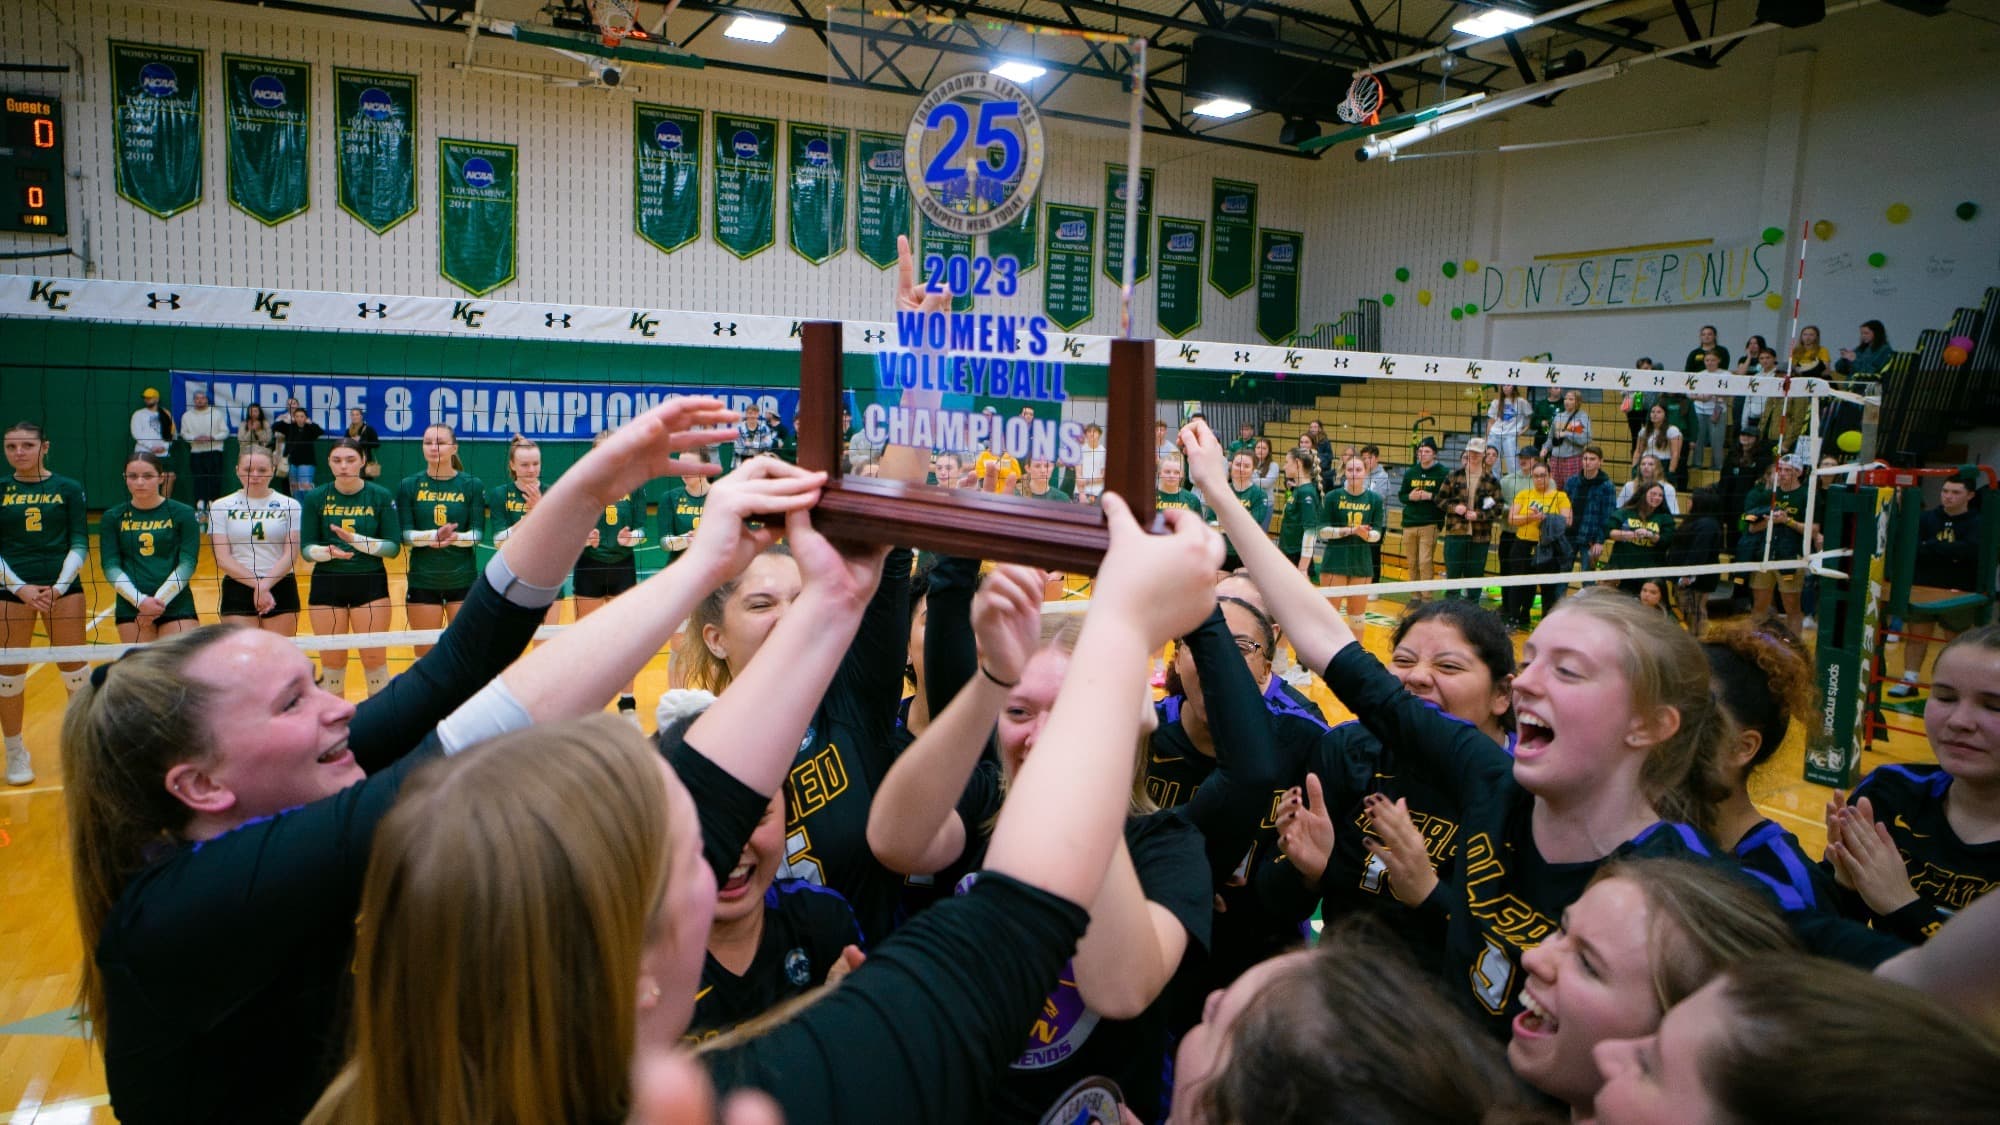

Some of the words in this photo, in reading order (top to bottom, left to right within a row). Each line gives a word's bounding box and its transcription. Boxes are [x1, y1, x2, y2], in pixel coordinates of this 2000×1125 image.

[120, 48, 160, 60] WOMEN'S
[161, 53, 194, 64] SOCCER
[239, 63, 263, 72] MEN'S
[264, 66, 296, 76] SOCCER
[143, 77, 178, 92] NCAA
[341, 75, 373, 85] WOMEN'S
[254, 89, 287, 105] NCAA
[915, 75, 987, 127] TOMORROW'S
[994, 78, 1037, 127] LEADERS
[6, 97, 51, 115] Guests
[237, 107, 300, 120] TOURNAMENT
[364, 101, 394, 115] NCAA
[34, 118, 54, 148] 0
[236, 122, 263, 132] 2007
[657, 132, 684, 146] NCAA
[925, 101, 1021, 183] 25
[449, 145, 470, 154] MEN'S
[735, 141, 760, 155] NCAA
[126, 152, 154, 162] 2010
[465, 170, 495, 184] NCAA
[28, 186, 44, 208] 0
[451, 186, 507, 198] TOURNAMENT
[448, 199, 473, 209] 2014
[921, 197, 963, 232] COMPETE
[966, 217, 991, 232] HERE
[993, 193, 1023, 225] TODAY
[23, 214, 48, 225] won
[925, 255, 1018, 297] 2023
[30, 280, 73, 312] KC
[254, 290, 291, 321] KC
[452, 301, 485, 328] KC
[629, 312, 660, 337] KC
[896, 310, 1049, 357] WOMEN'S
[1062, 336, 1086, 359] KC
[1180, 344, 1200, 364] KC
[1284, 350, 1303, 370] KC
[1379, 356, 1396, 376] KC
[878, 350, 1067, 401] VOLLEYBALL
[1466, 361, 1483, 380] KC
[1545, 366, 1561, 385] KC
[1618, 371, 1634, 388] KC
[384, 386, 414, 433] 8
[864, 403, 1084, 466] CHAMPIONS
[1410, 479, 1437, 488] KEUKA
[1, 492, 64, 507] KEUKA
[417, 489, 465, 504] KEUKA
[322, 503, 375, 517] KEUKA
[676, 504, 704, 515] KEU
[1338, 500, 1371, 511] KEUKA
[25, 507, 43, 532] 2
[227, 508, 289, 522] KEUKA
[434, 505, 448, 527] 6
[120, 517, 174, 533] KEUKA
[250, 521, 266, 541] 4
[340, 518, 356, 533] 5
[138, 532, 155, 557] 3
[1018, 1040, 1073, 1066] ENDS
